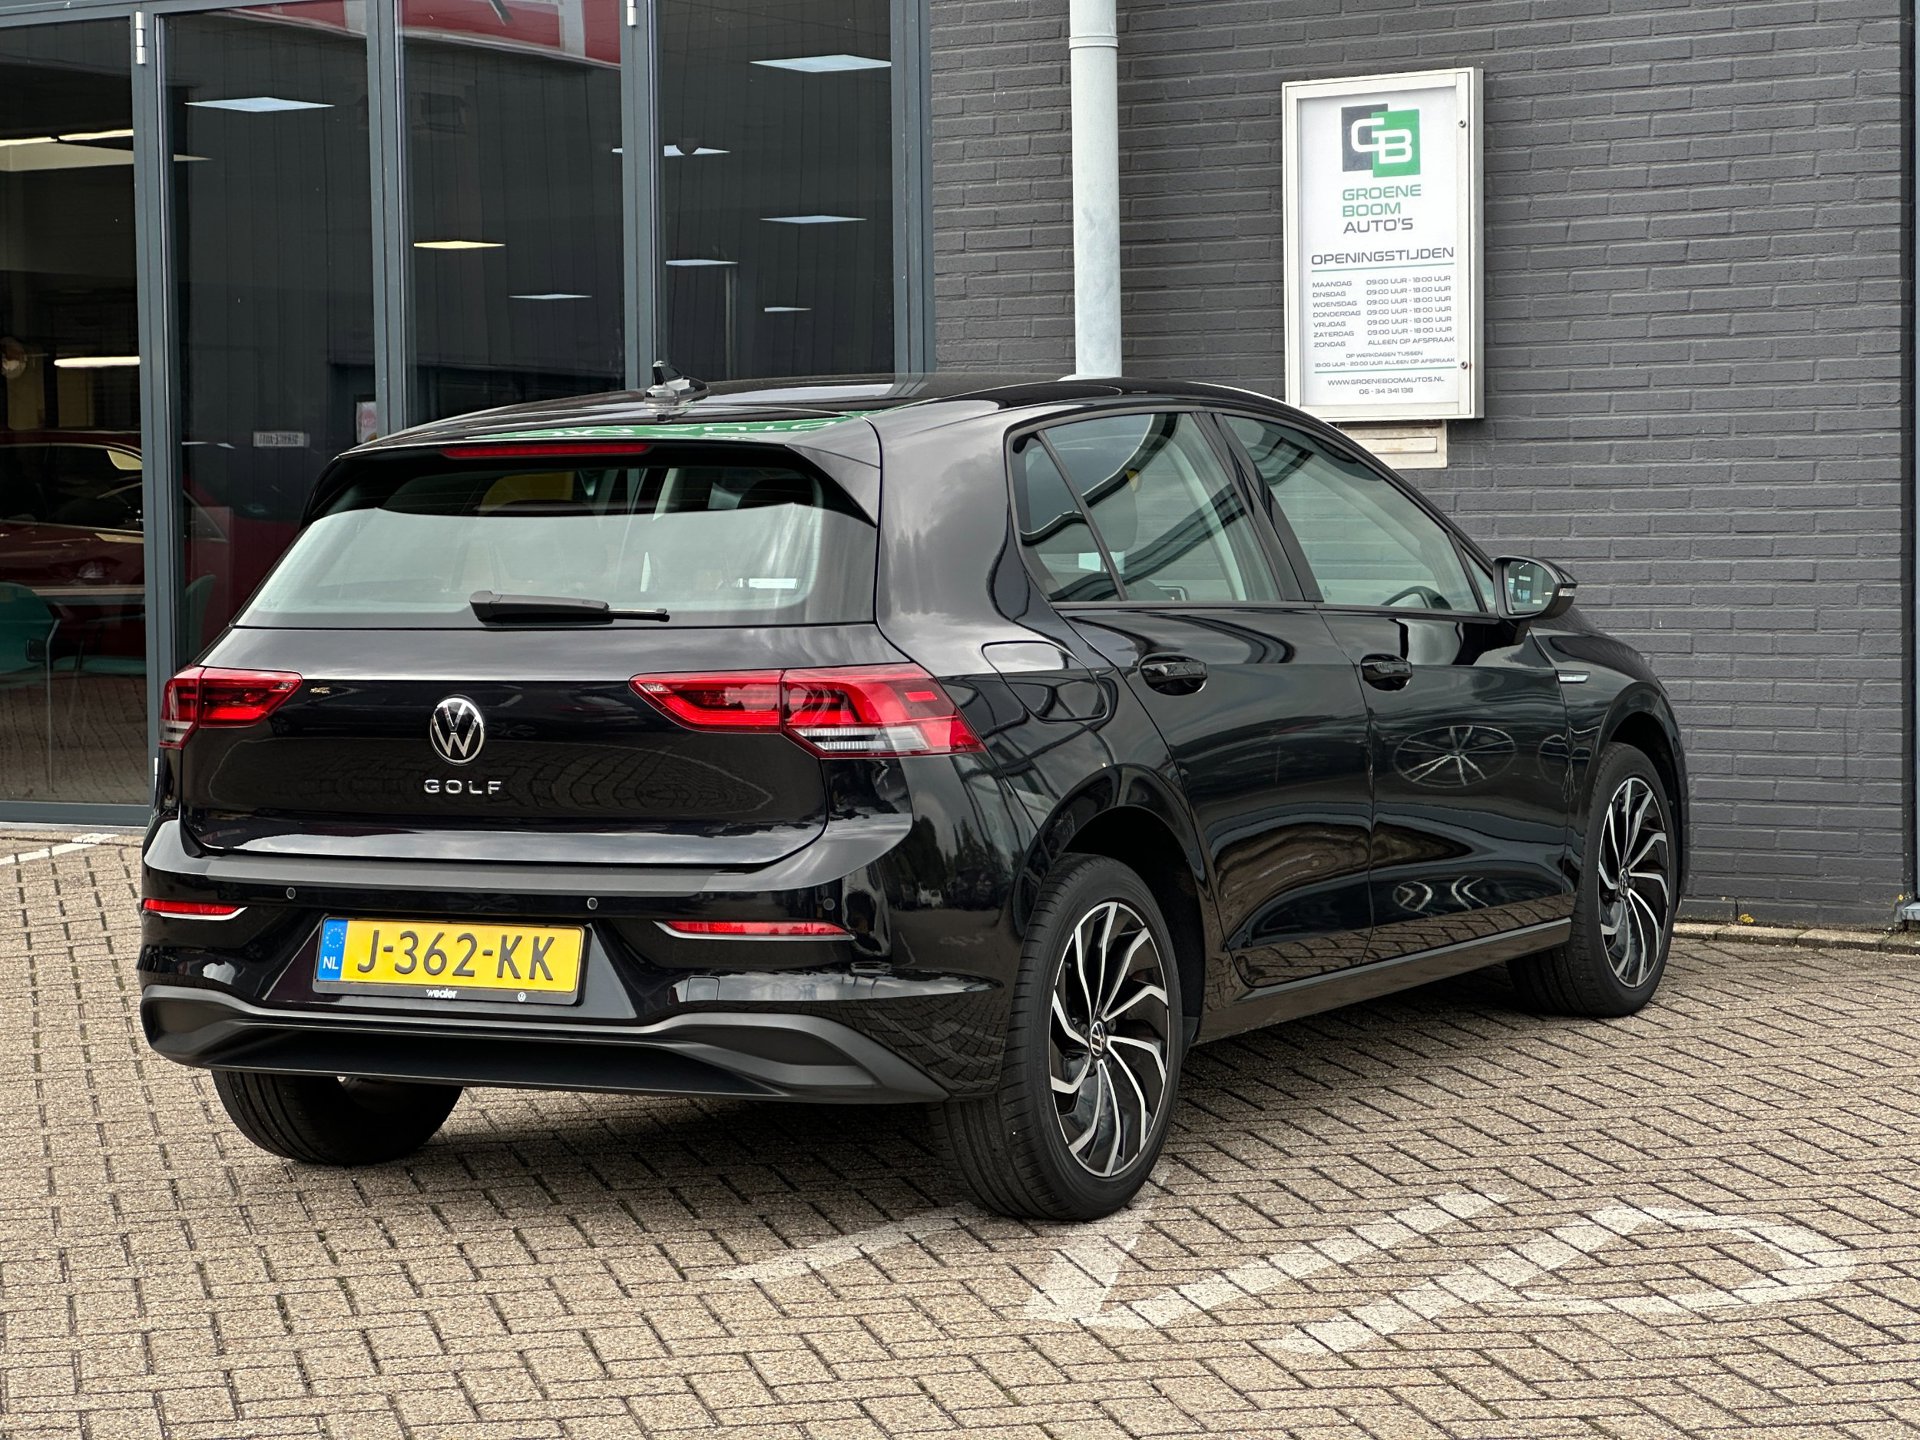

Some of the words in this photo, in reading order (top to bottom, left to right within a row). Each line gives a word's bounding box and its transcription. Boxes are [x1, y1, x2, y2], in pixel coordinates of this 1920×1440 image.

[1342, 183, 1422, 202] GROENE
[1342, 201, 1401, 218] BOOM
[1342, 217, 1414, 234] AUTO'S
[1311, 246, 1454, 265] OPENINGSTIJDEN
[1311, 280, 1352, 288] MAANDAG
[1312, 290, 1346, 298] DINSDAG
[1390, 287, 1408, 295] UUR
[1433, 285, 1452, 293] UUR
[1312, 300, 1358, 308] WOENSDAG
[1390, 297, 1408, 305] UUR
[1434, 295, 1452, 303] UUR
[1312, 310, 1362, 318] DONDERDAG
[1390, 307, 1408, 315] UUR
[1434, 305, 1452, 313] UUR
[1312, 320, 1346, 328] VRIJDAG
[1390, 317, 1408, 325] UUR
[1434, 315, 1452, 323] UUR
[1313, 330, 1355, 338] ZATERDAG
[1390, 327, 1408, 335] UUR
[1313, 340, 1346, 348] ZONDAG
[1367, 338, 1398, 346] ALLEEN
[1411, 336, 1455, 344] AFSPRAAK
[424, 779, 502, 795] GOLF
[357, 929, 555, 981] J-362-KK
[323, 956, 339, 970] NL
